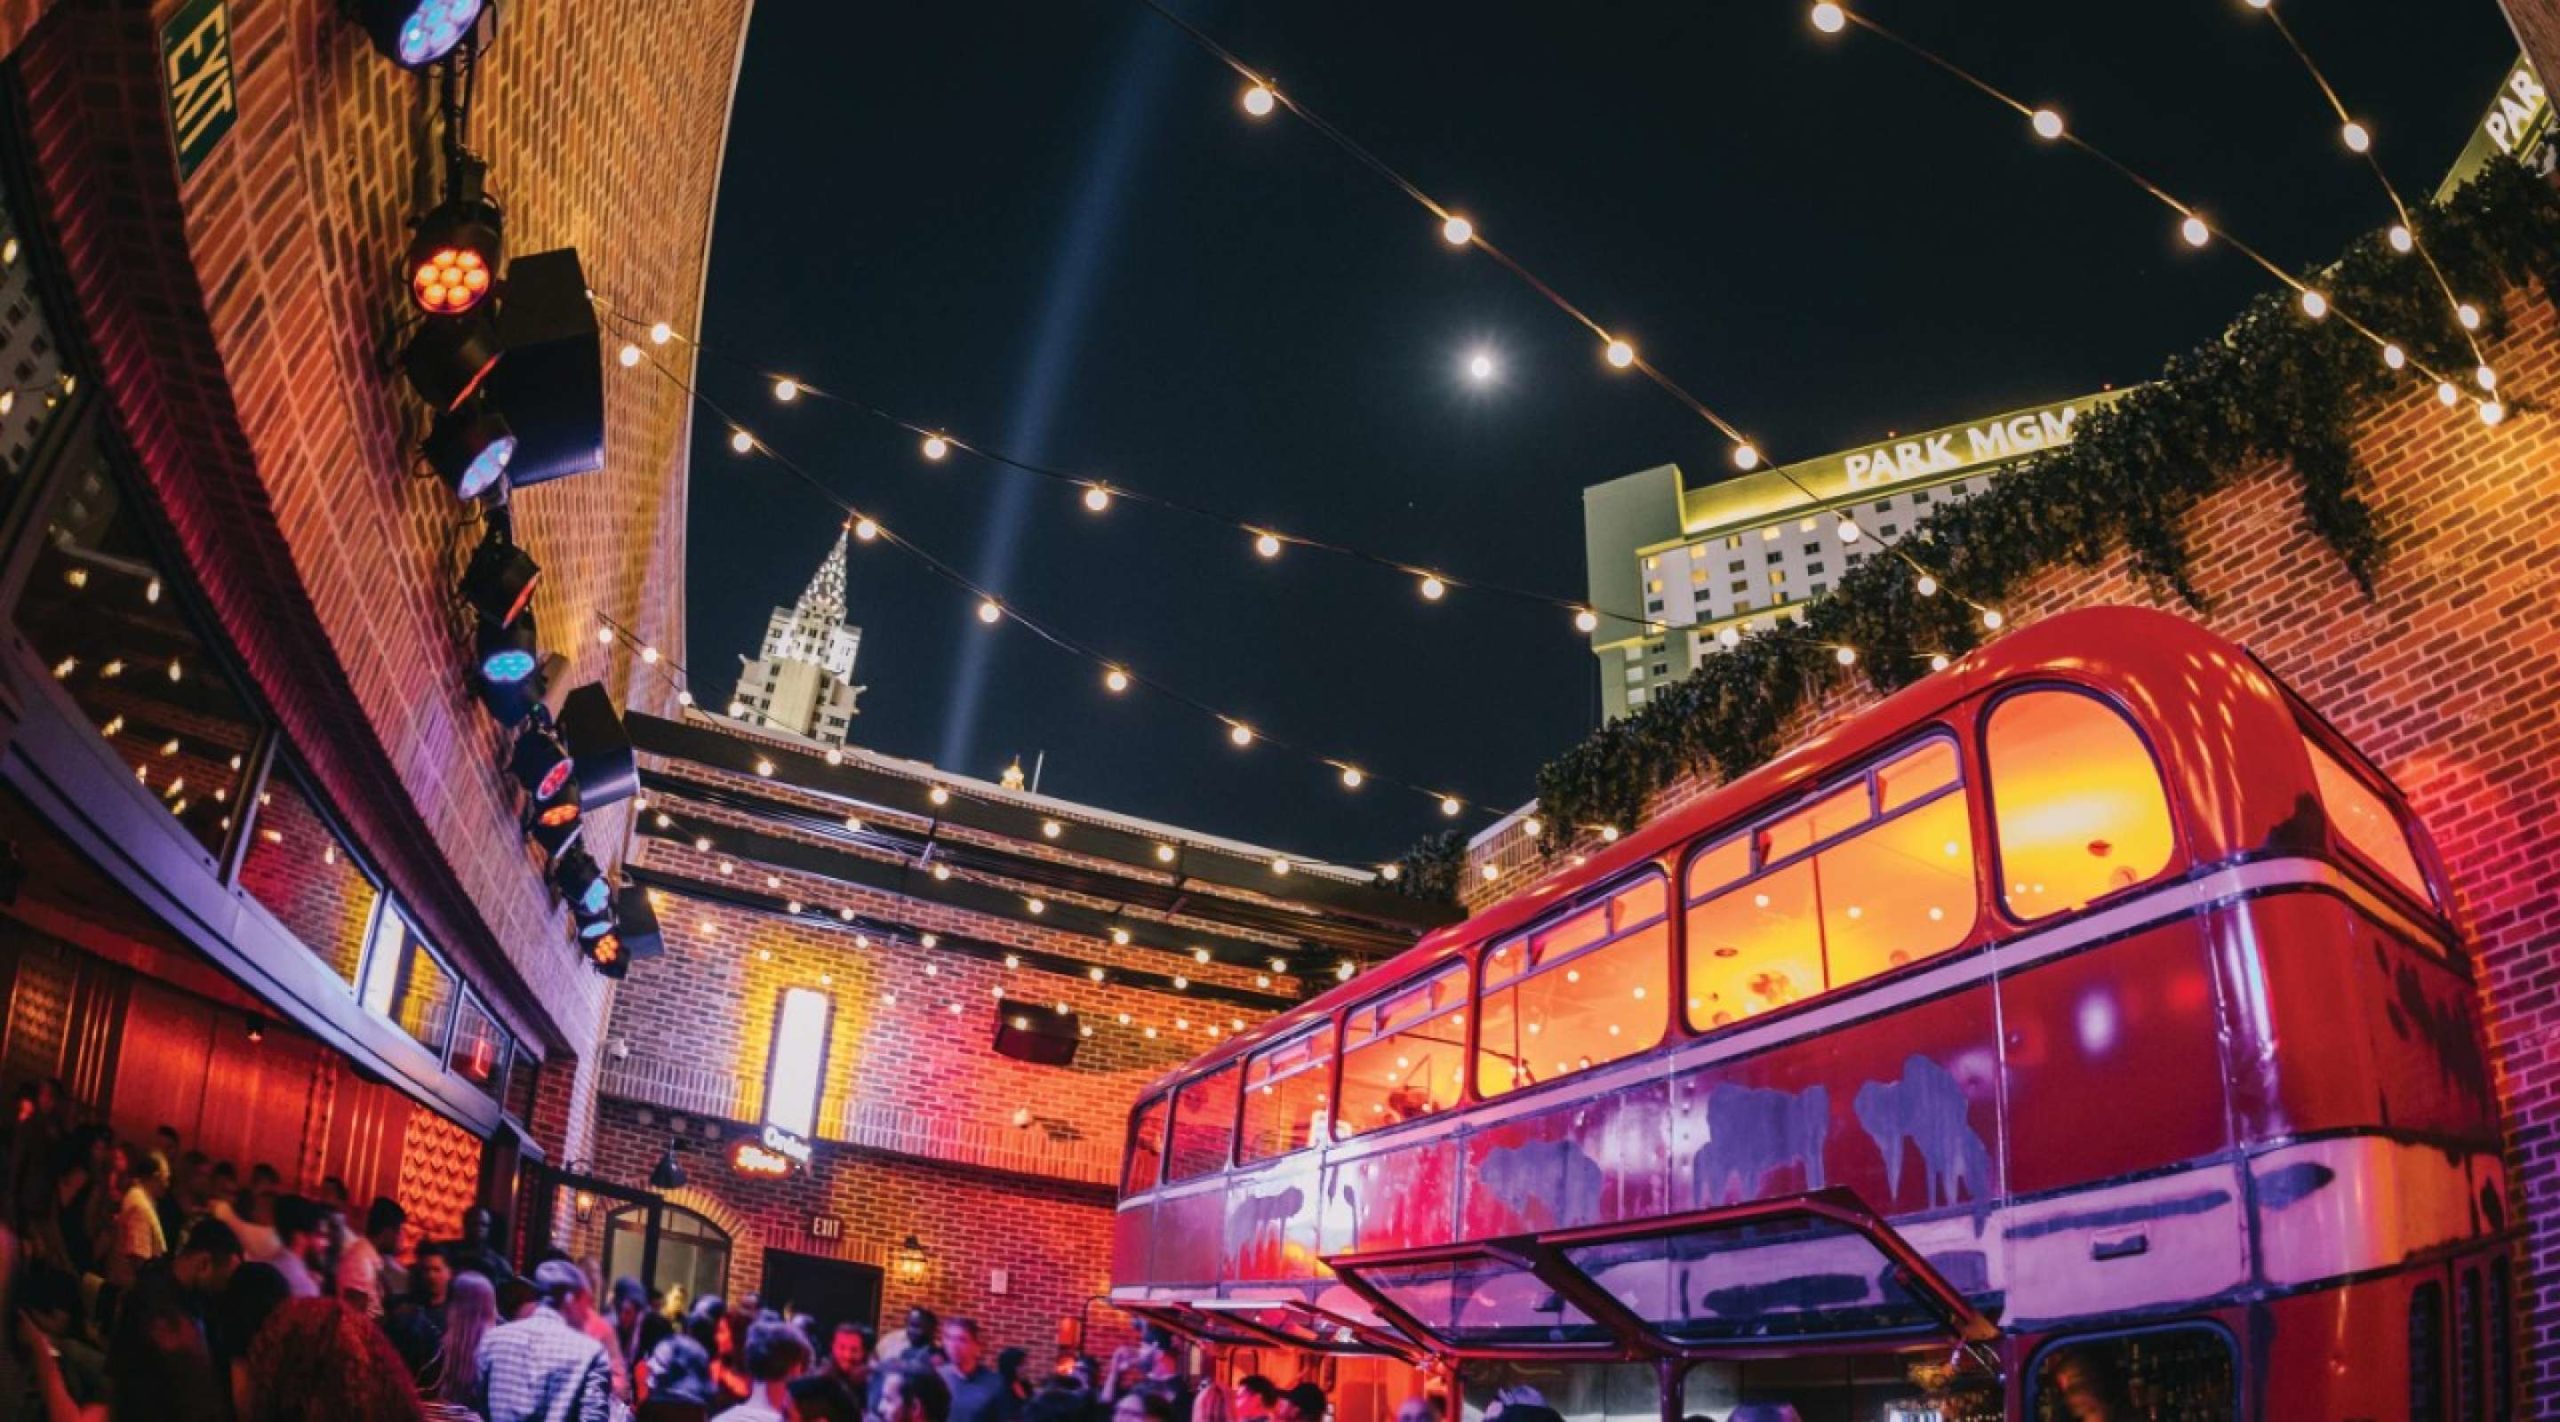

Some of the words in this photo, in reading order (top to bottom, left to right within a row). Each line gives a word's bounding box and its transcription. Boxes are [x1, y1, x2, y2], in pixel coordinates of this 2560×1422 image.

[168, 1, 233, 153] EXIT
[2485, 68, 2546, 154] PAR
[1844, 433, 1961, 490] PARK
[1967, 406, 2077, 461] MGM
[813, 1216, 840, 1239] EXIT
